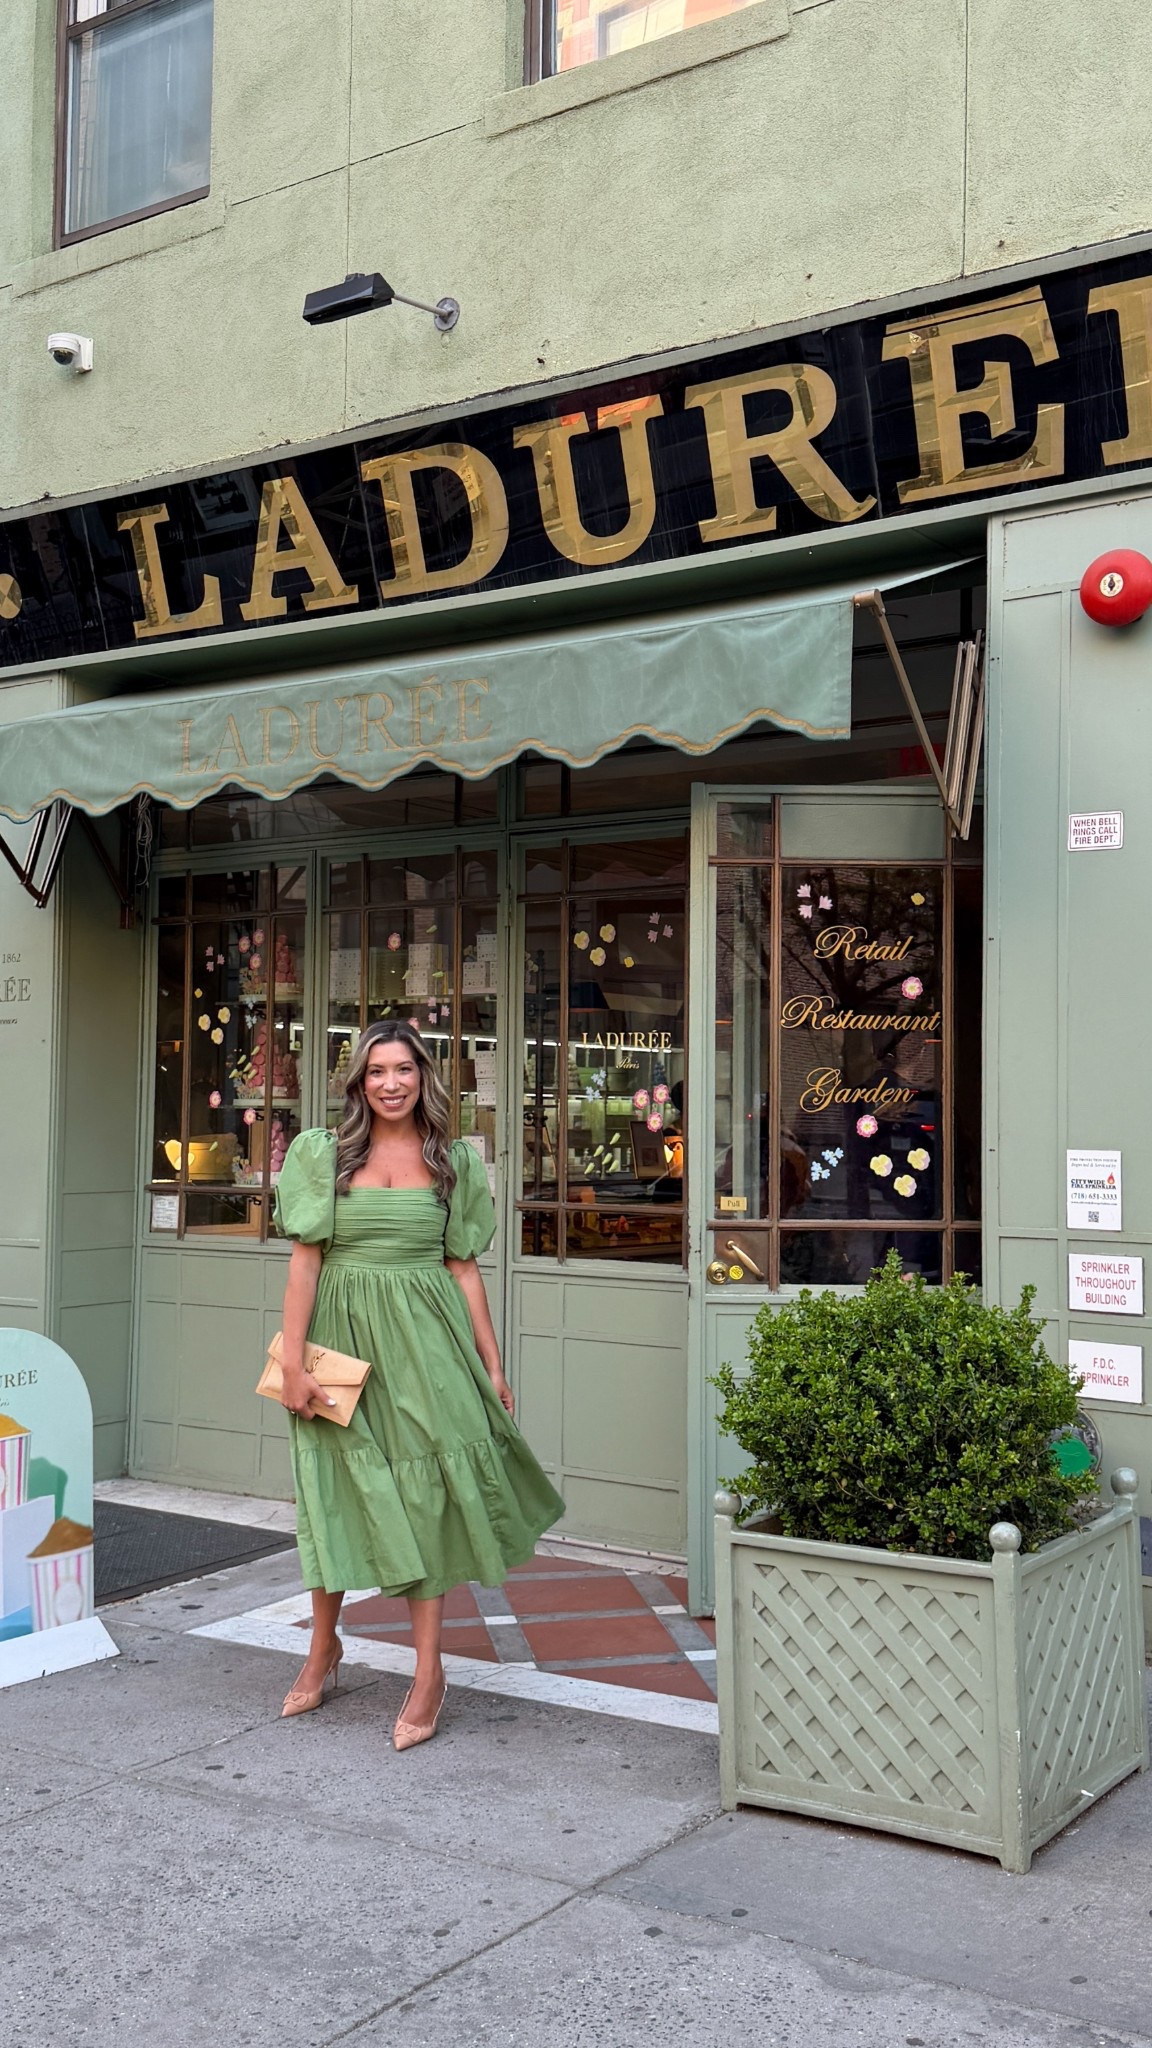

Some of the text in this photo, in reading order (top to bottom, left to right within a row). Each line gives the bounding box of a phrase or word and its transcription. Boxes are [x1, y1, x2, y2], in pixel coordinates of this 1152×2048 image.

[176, 674, 493, 776] LADURÉE
[1073, 817, 1118, 828] WHEN BELL
[1072, 826, 1118, 836] RINGS CALL
[1074, 835, 1116, 845] FIRE DEPT.
[813, 925, 913, 961] Retail
[2, 953, 21, 964] 1862
[780, 994, 941, 1031] Restaurant
[582, 1029, 672, 1049] LADURÉE
[615, 1056, 640, 1070] Paris
[799, 1067, 914, 1113] Garden
[727, 1199, 741, 1207] Pull
[1071, 1192, 1088, 1200] (718)
[1081, 1261, 1130, 1275] SPRINKLER
[1075, 1276, 1137, 1291] THROUGHOUT
[1085, 1292, 1127, 1306] BUILDING
[1093, 1357, 1116, 1370] F.D.C.
